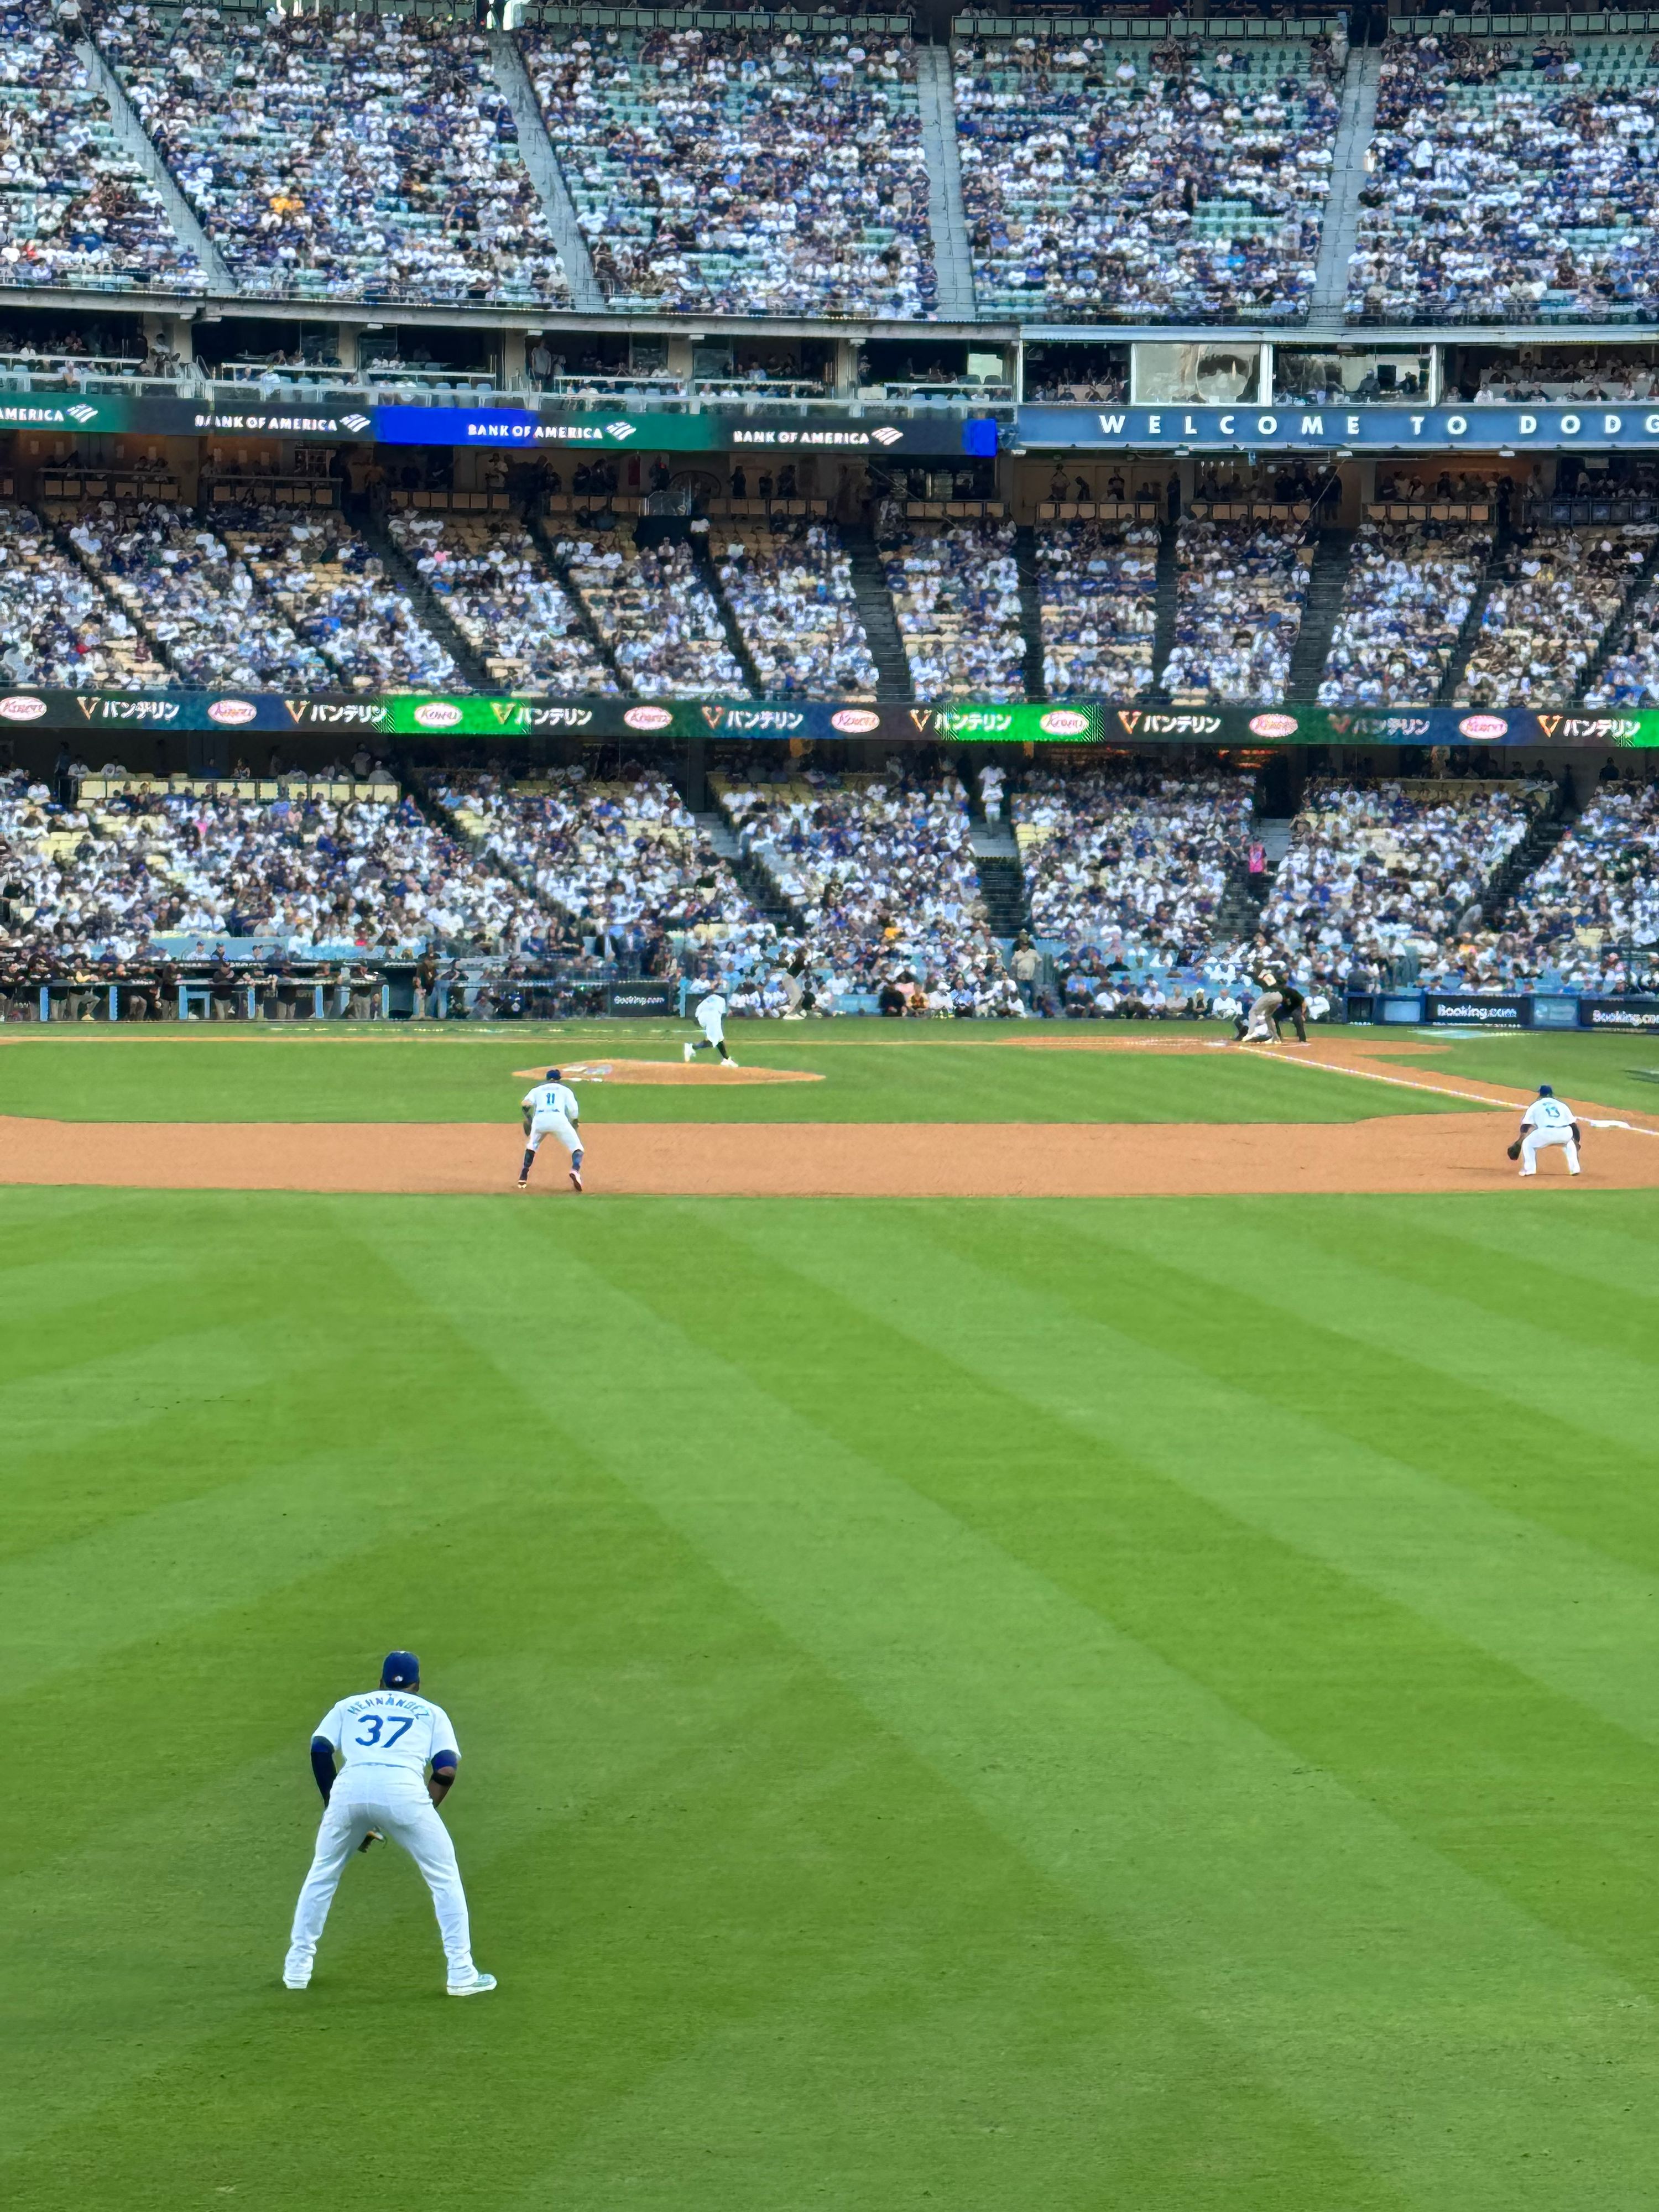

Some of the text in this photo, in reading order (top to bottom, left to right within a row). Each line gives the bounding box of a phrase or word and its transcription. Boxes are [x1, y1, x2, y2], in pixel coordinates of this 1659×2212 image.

[246, 417, 266, 429] OF
[268, 418, 337, 431] AMERICA
[468, 424, 603, 439] BANK OF AMERICA
[1099, 415, 1659, 435] WELCOME TO DODG
[733, 431, 869, 445] BANK OF AMERICA
[311, 703, 387, 724] バンテリン
[516, 706, 593, 726] バンテリン
[1143, 715, 1221, 734] バンテリン
[1562, 718, 1641, 737] バンテリン
[1437, 1004, 1517, 1020] Booking.com
[1592, 1009, 1659, 1026] Booking.co
[355, 1714, 414, 1748] 37
